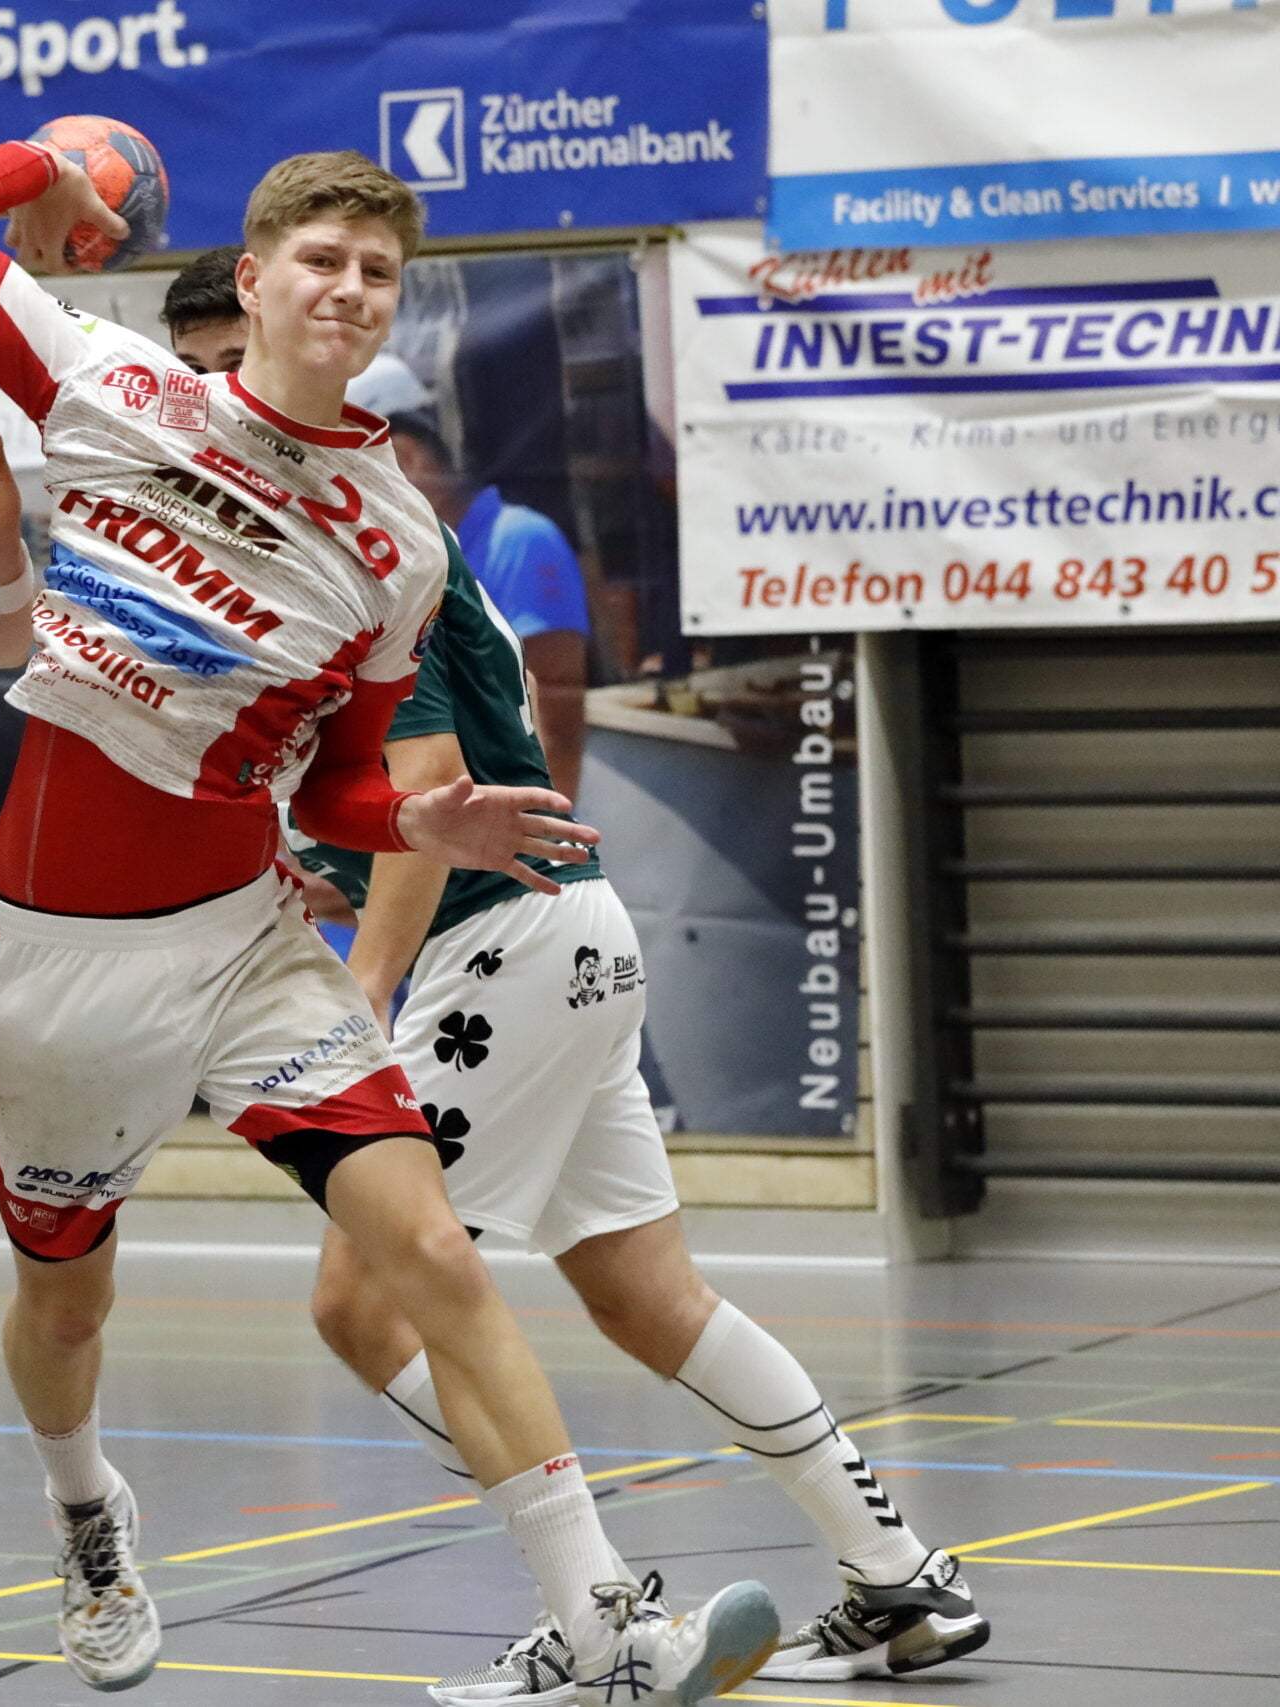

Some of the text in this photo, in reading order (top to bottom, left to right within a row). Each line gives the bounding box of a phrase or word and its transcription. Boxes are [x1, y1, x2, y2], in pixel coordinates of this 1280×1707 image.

[480, 88, 619, 134] Zürcher
[480, 121, 734, 175] Kantonalbank
[833, 189, 942, 229] Facility
[949, 187, 974, 218] &
[979, 181, 1063, 217] Clean
[1068, 177, 1200, 212] Services
[167, 373, 207, 397] HCH
[1058, 414, 1127, 444] und
[1151, 409, 1280, 445] Energ
[58, 490, 284, 642] FROMM
[738, 562, 925, 608] Telefon
[943, 560, 1033, 604] 044
[1053, 557, 1148, 601] 843
[1166, 552, 1232, 598] 40
